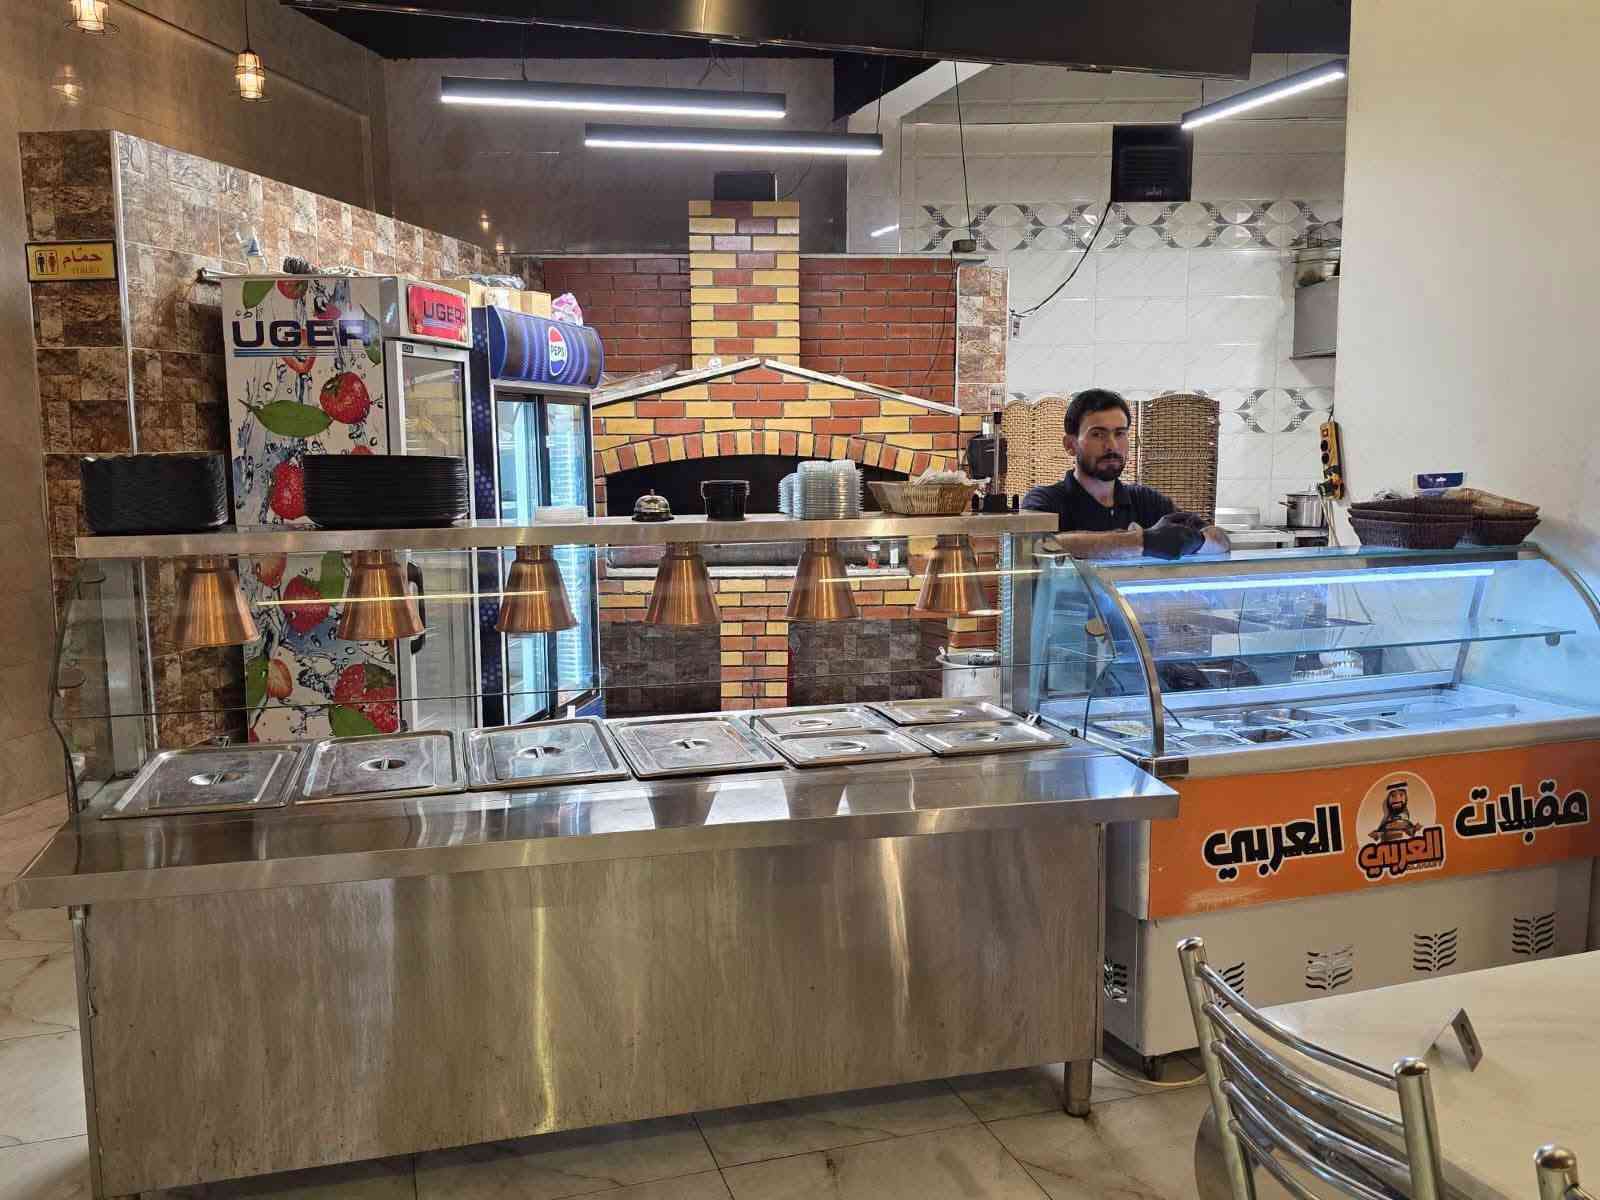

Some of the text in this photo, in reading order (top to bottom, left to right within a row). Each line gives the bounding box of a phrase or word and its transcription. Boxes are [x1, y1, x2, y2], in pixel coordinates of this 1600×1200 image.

[232, 319, 371, 348] UGER
[1203, 780, 1590, 880] مقبلات العربي
[1357, 826, 1444, 879] العربي
